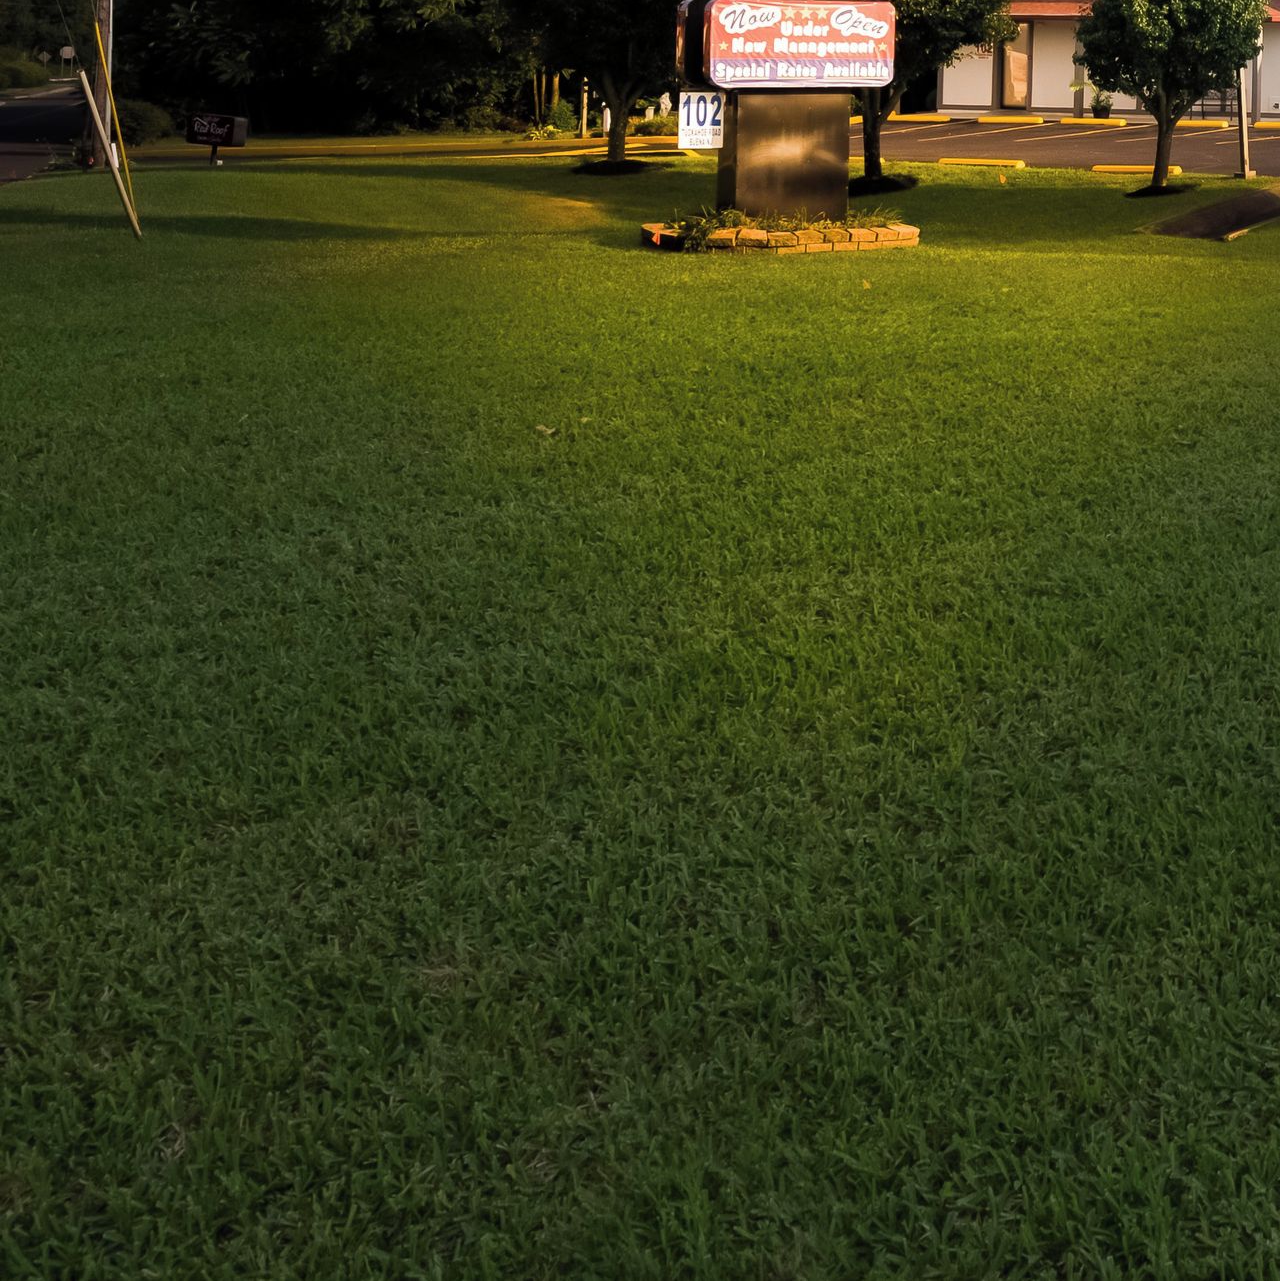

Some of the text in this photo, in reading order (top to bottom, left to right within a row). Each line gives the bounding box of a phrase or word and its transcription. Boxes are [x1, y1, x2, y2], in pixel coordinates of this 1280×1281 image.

[724, 9, 885, 35] Now Open
[780, 21, 830, 37] Under
[731, 37, 876, 58] New Management
[715, 62, 890, 82] Special Rates Available
[682, 95, 722, 126] 102
[210, 122, 230, 137] Roof
